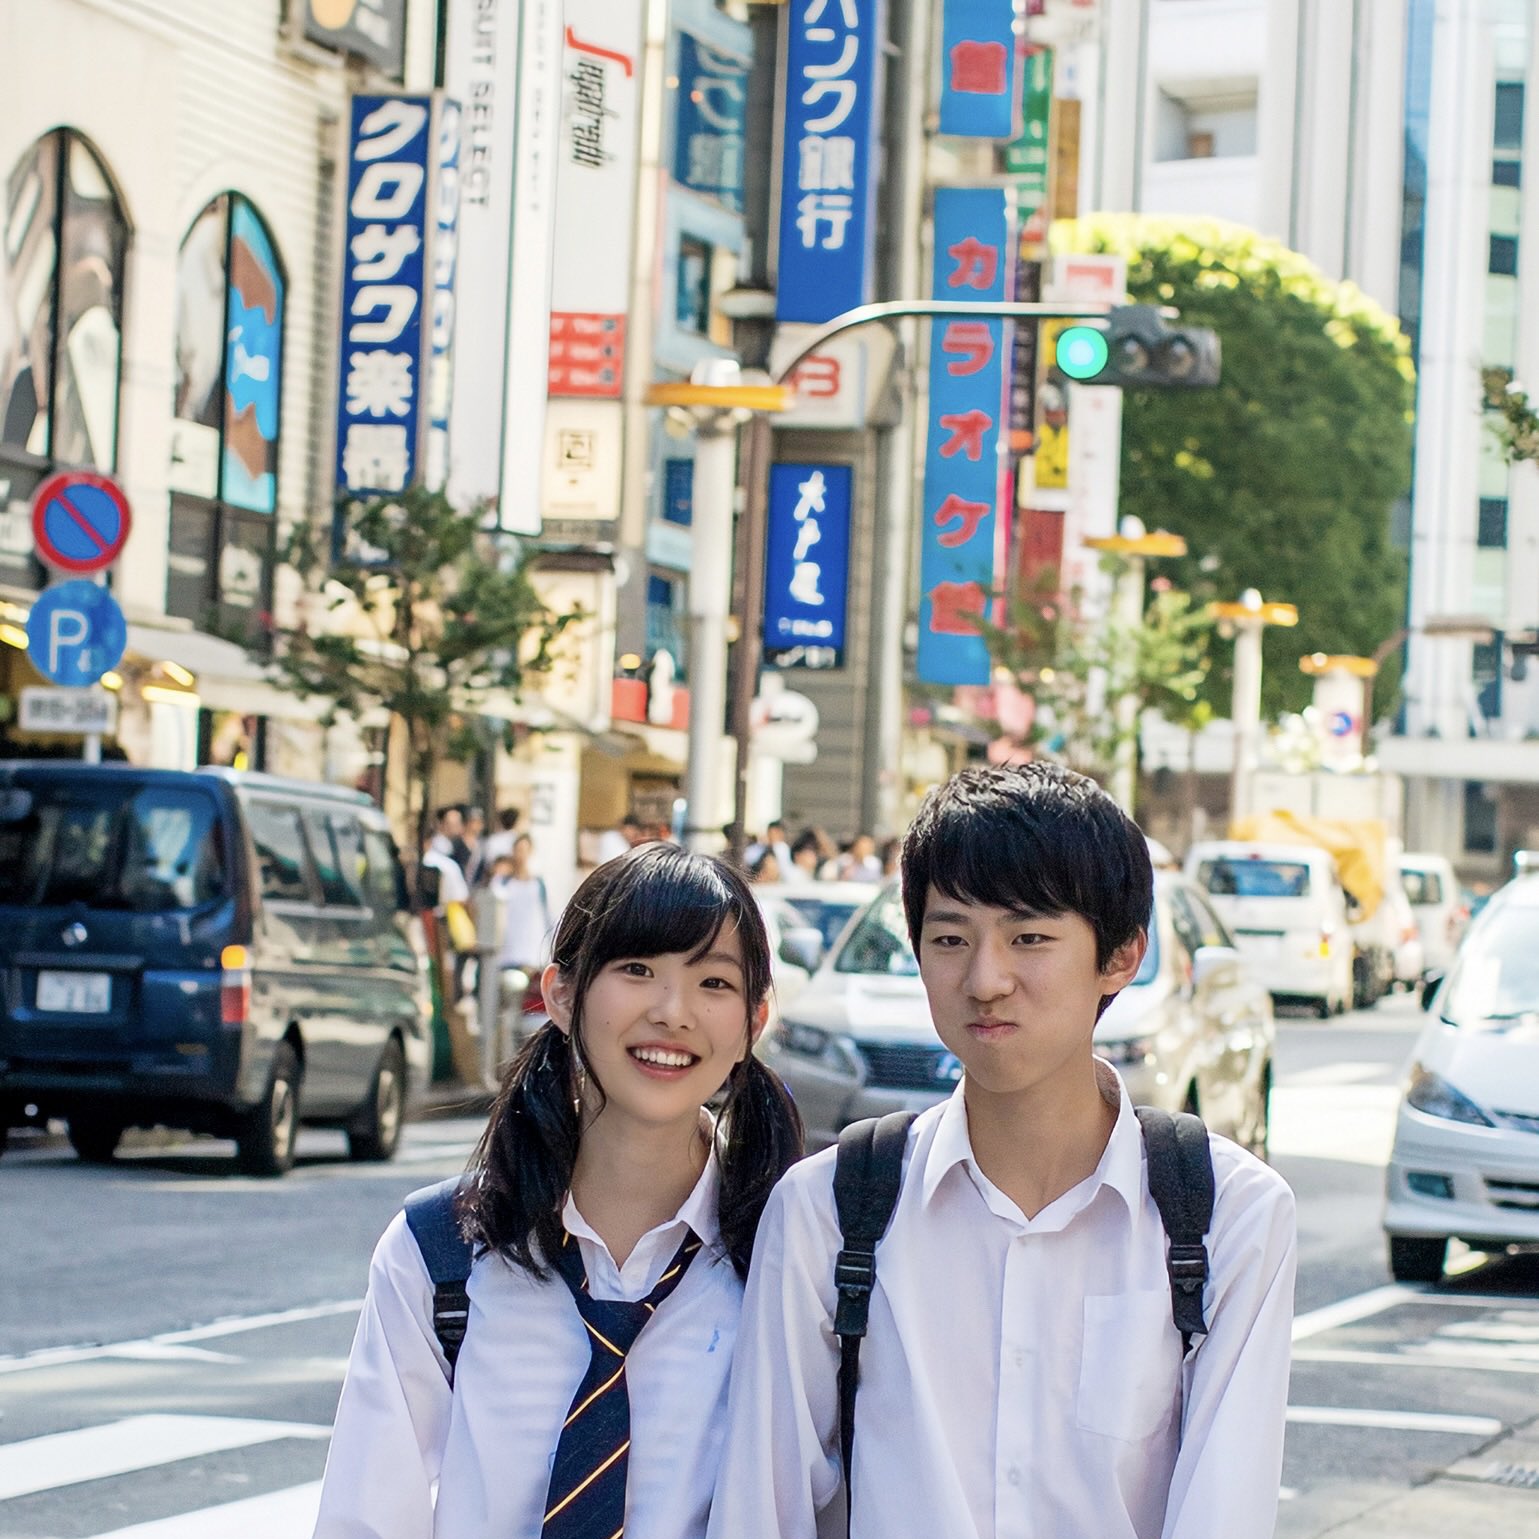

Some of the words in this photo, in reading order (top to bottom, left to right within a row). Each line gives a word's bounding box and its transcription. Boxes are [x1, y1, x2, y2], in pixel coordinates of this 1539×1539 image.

[341, 99, 428, 492] クロサワ楽器
[49, 609, 88, 673] P
